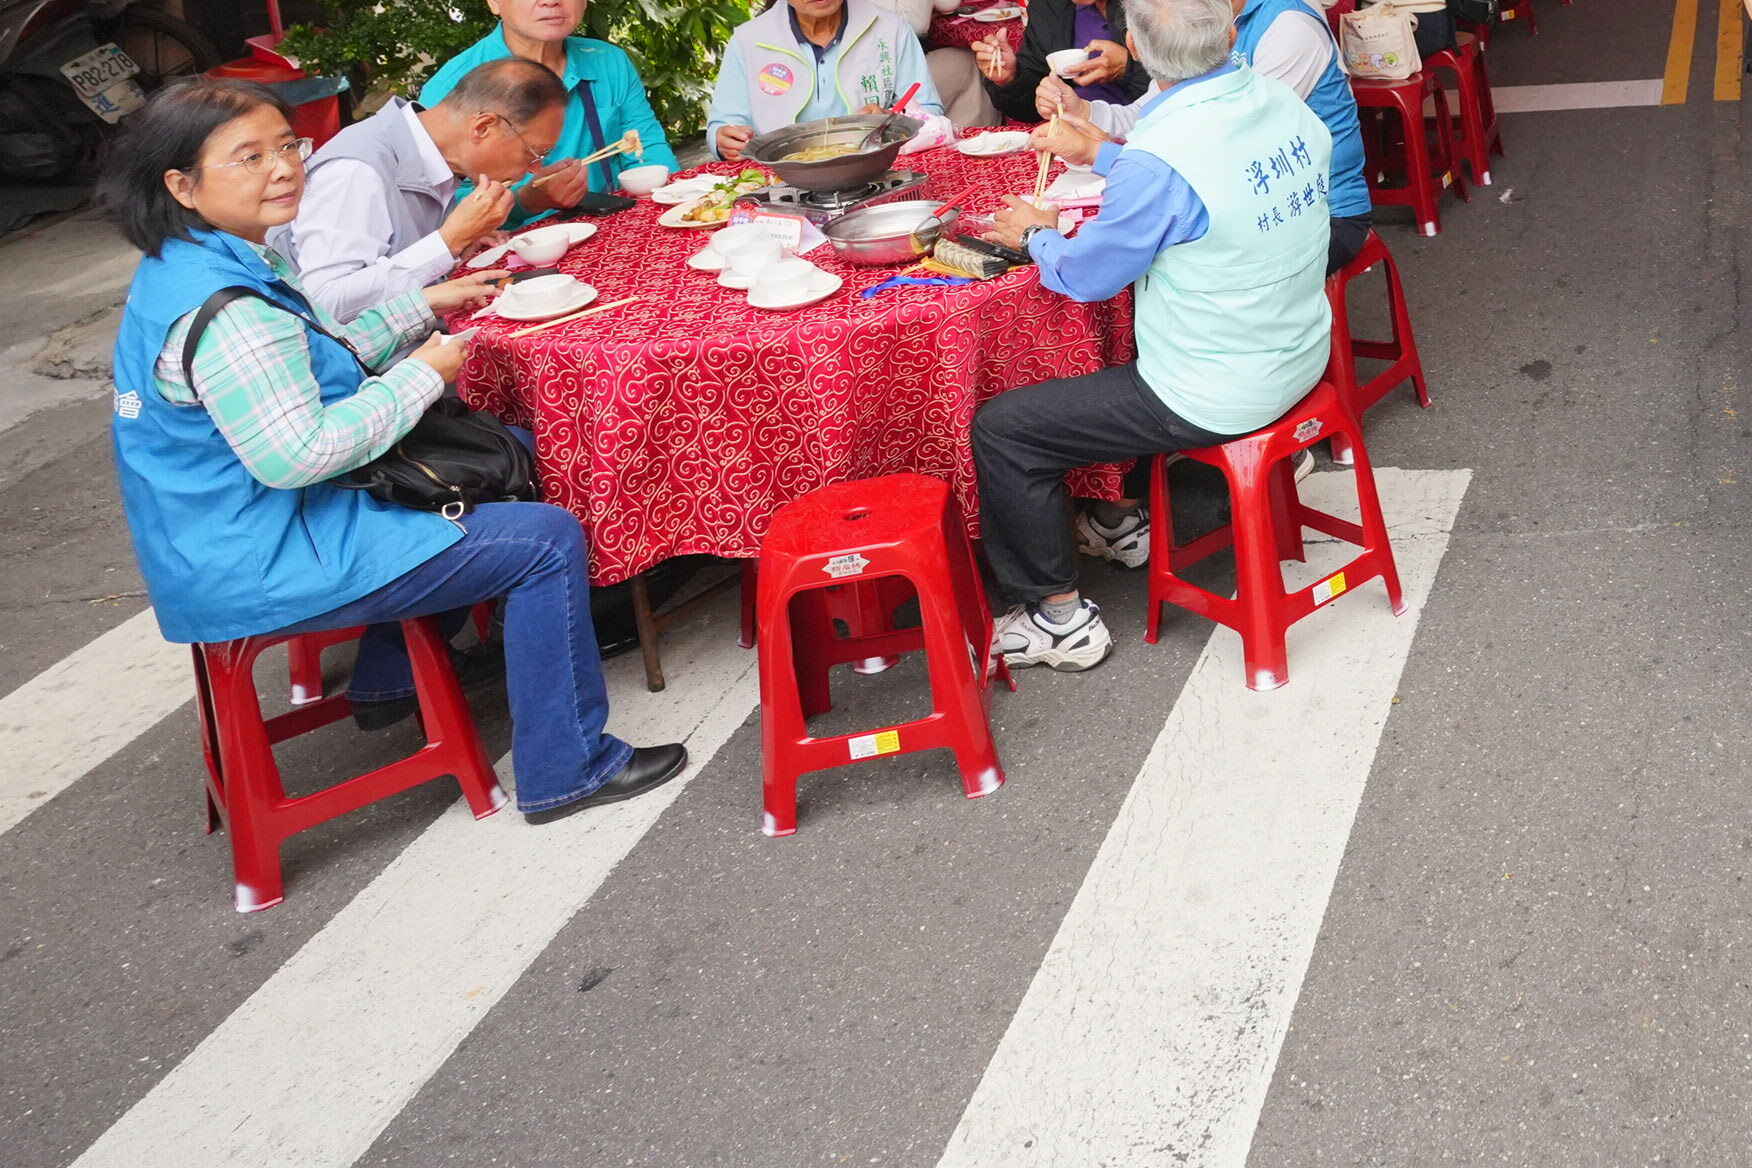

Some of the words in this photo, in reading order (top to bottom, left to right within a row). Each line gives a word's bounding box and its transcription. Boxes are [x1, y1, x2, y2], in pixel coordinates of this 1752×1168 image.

[1245, 135, 1312, 196] 浮圳村
[1257, 206, 1285, 233] 村長
